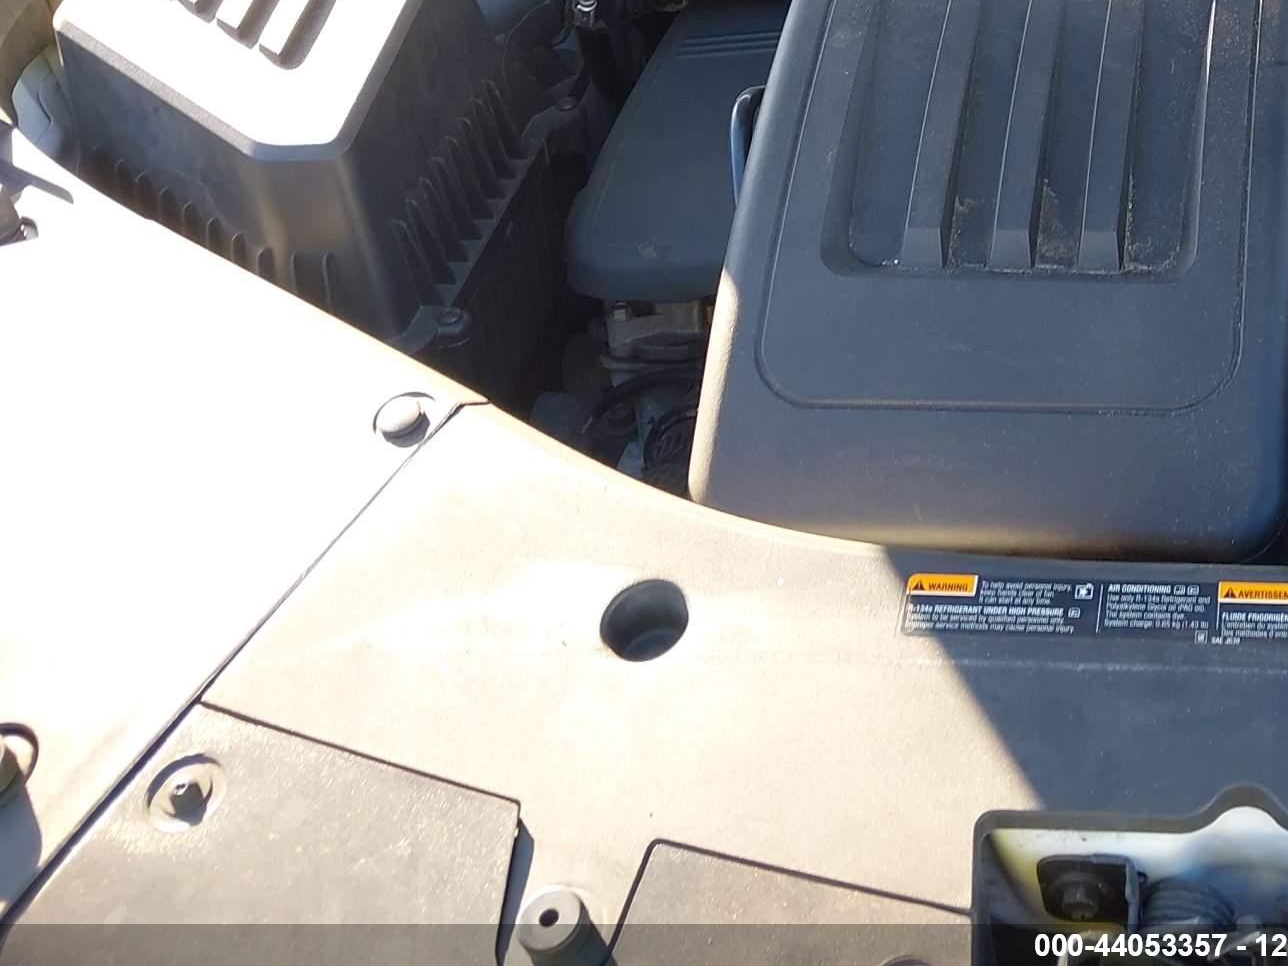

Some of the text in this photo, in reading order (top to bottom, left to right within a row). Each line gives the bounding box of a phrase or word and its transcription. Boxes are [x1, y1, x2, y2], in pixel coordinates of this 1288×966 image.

[929, 583, 968, 591] WARNING
[1108, 584, 1171, 594] AIR CONDITIONING
[934, 604, 982, 614] REFRIGERANT
[984, 605, 1007, 615] UNDER
[1009, 606, 1025, 615] HIGH
[1027, 607, 1064, 617] PRESSURE
[1222, 612, 1246, 620] FLUIDE
